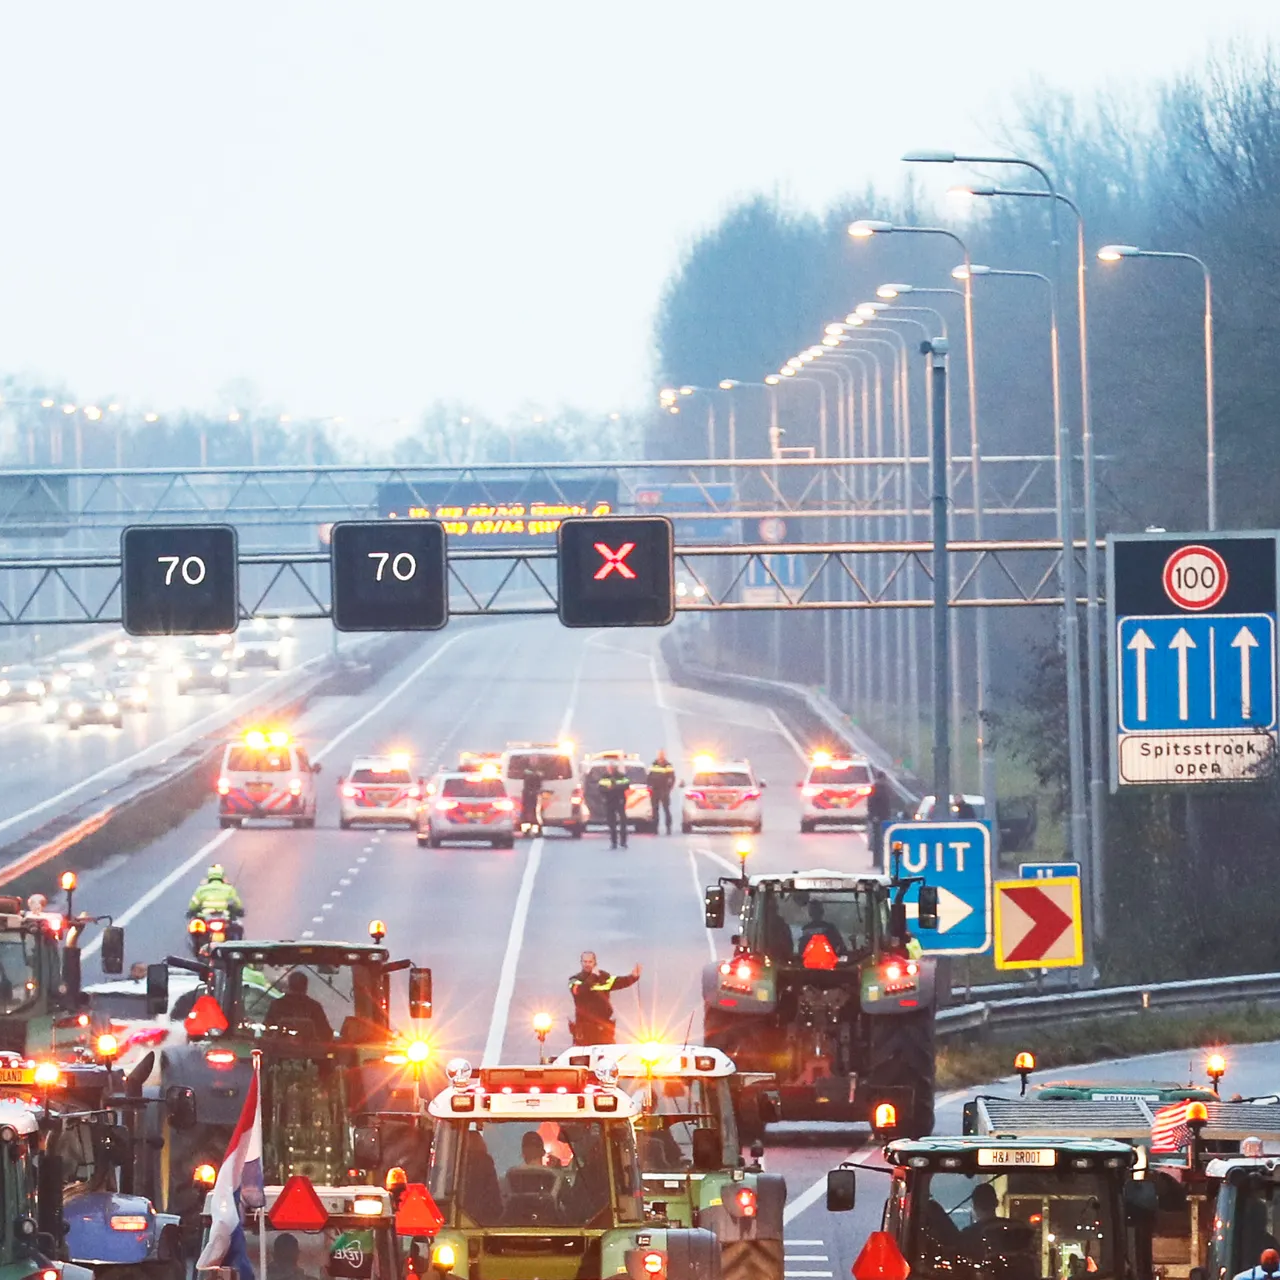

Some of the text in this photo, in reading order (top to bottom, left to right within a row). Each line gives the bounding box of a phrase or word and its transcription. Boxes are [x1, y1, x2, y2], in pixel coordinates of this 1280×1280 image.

[157, 556, 206, 586] 70
[368, 552, 417, 581] 70
[1175, 566, 1216, 589] 100
[1174, 762, 1221, 777] open
[902, 842, 971, 873] UIT
[992, 1152, 1041, 1164] H&A GROOT
